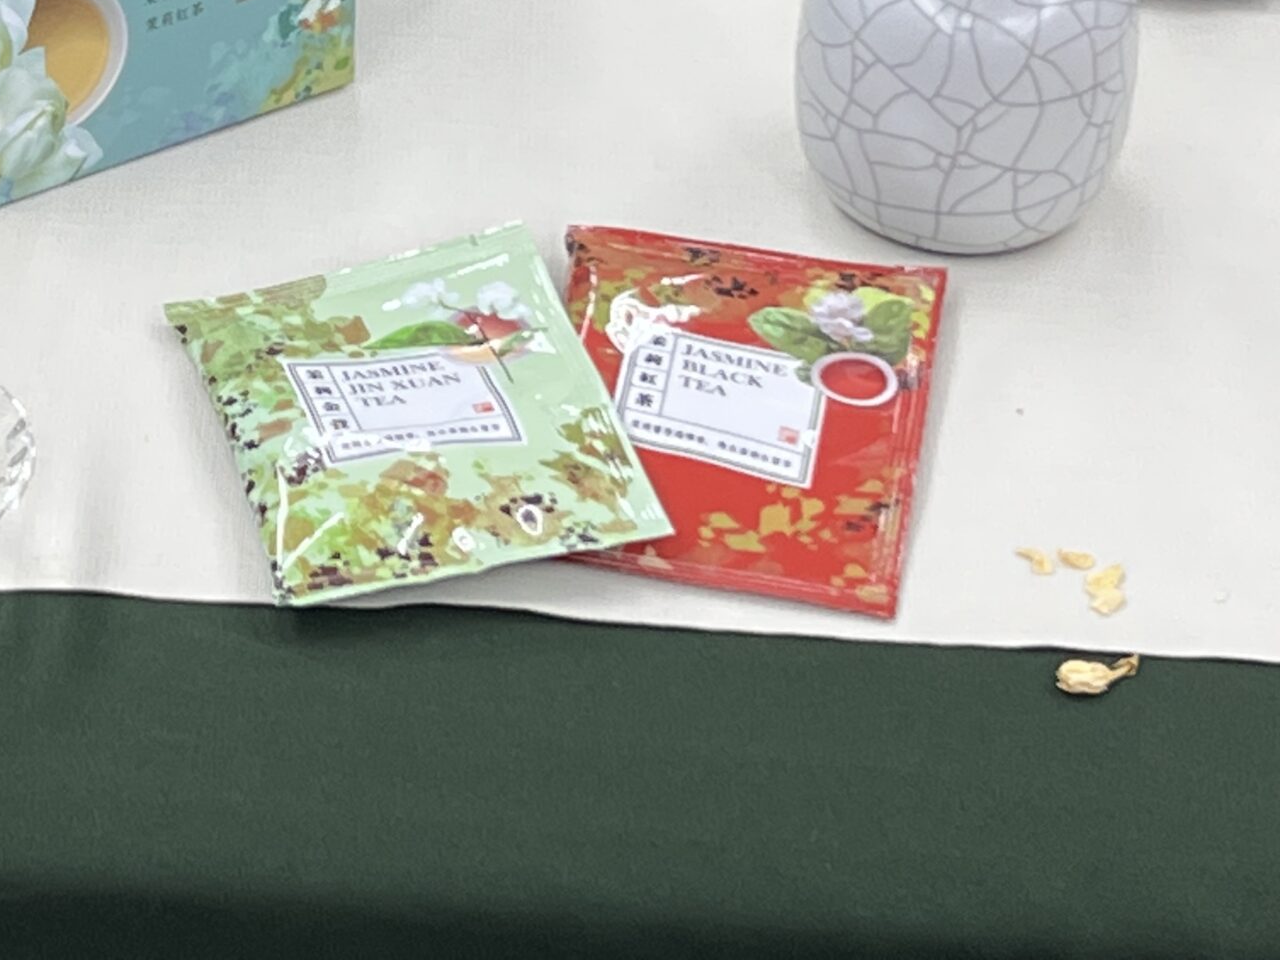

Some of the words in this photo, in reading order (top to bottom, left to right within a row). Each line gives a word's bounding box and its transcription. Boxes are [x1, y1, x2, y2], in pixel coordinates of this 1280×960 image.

[341, 360, 447, 382] JASMINE
[681, 344, 788, 377] JASMINE
[348, 381, 385, 395] JIN
[392, 372, 462, 391] XUAN
[678, 374, 727, 397] TEA
[681, 359, 763, 389] BLACK
[358, 394, 407, 408] TEA
